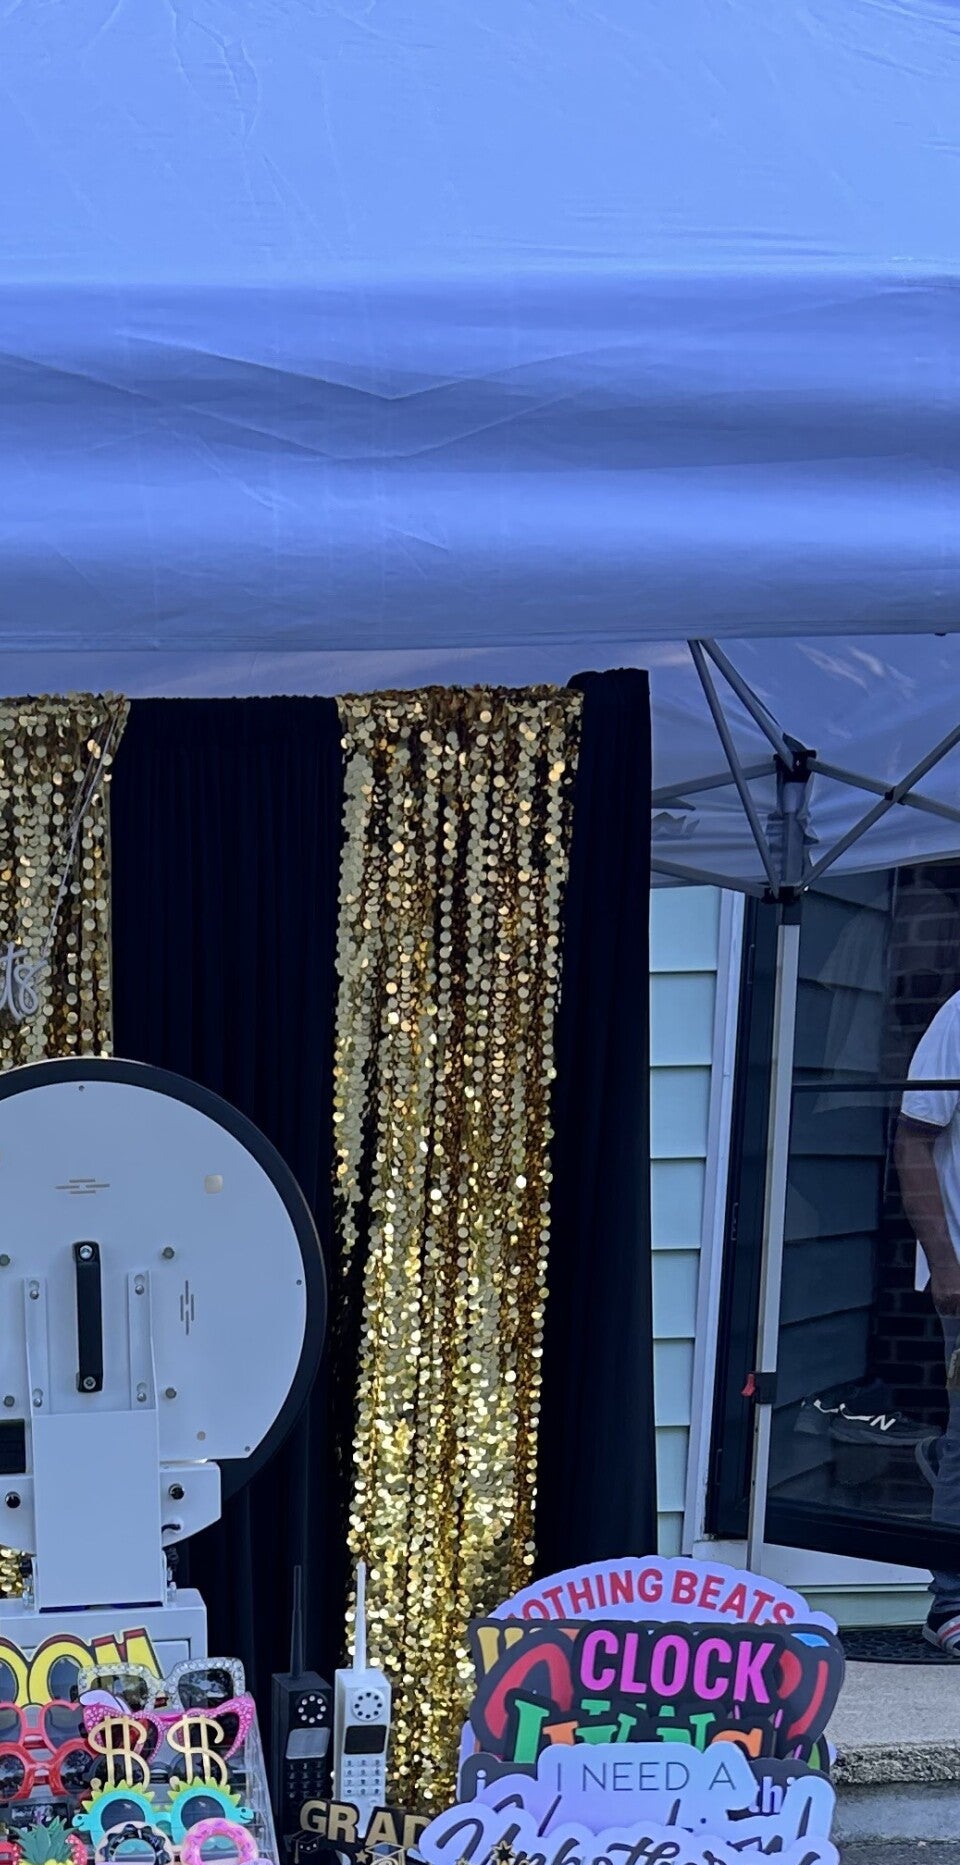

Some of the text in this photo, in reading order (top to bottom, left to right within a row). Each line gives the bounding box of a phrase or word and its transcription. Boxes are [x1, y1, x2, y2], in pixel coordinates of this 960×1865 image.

[507, 1568, 796, 1625] OTHING BEATS
[580, 1629, 776, 1704] CLOCK
[582, 1761, 691, 1792] NEED
[708, 1760, 737, 1792] A
[300, 1801, 432, 1848] GRAD
